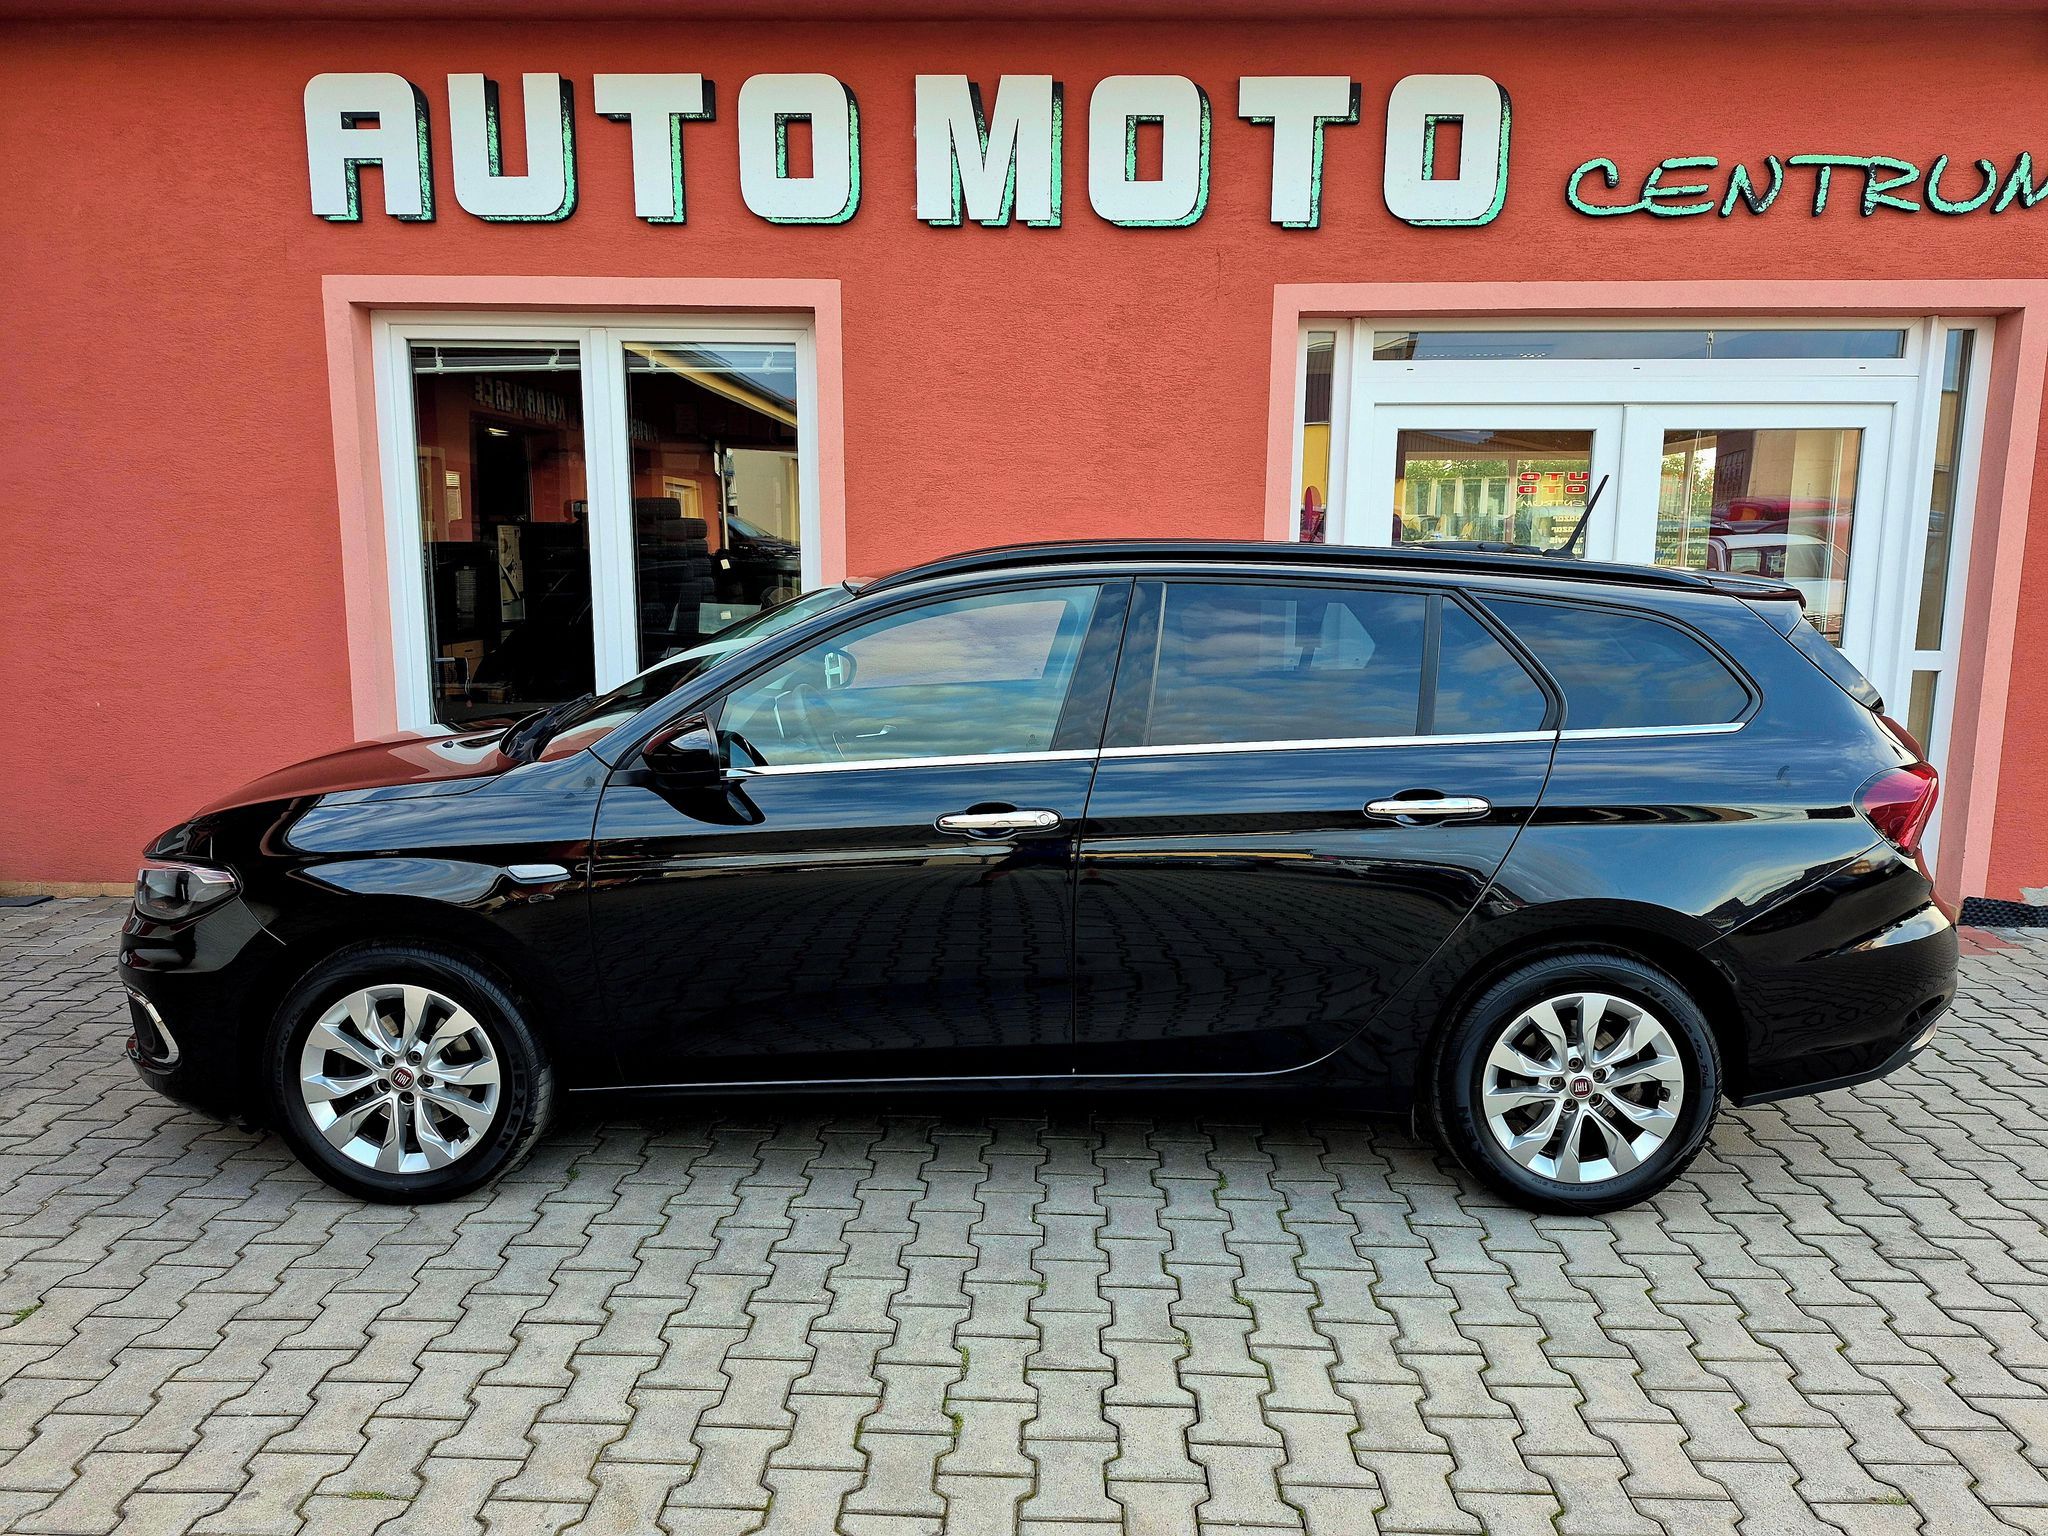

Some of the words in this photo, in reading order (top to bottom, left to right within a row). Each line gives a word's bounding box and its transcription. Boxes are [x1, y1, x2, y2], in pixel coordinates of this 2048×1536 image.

[303, 73, 861, 225] AUTO
[914, 74, 1511, 228] MOTO
[394, 1071, 411, 1086] FIAT
[1574, 1081, 1589, 1094] FIAT
